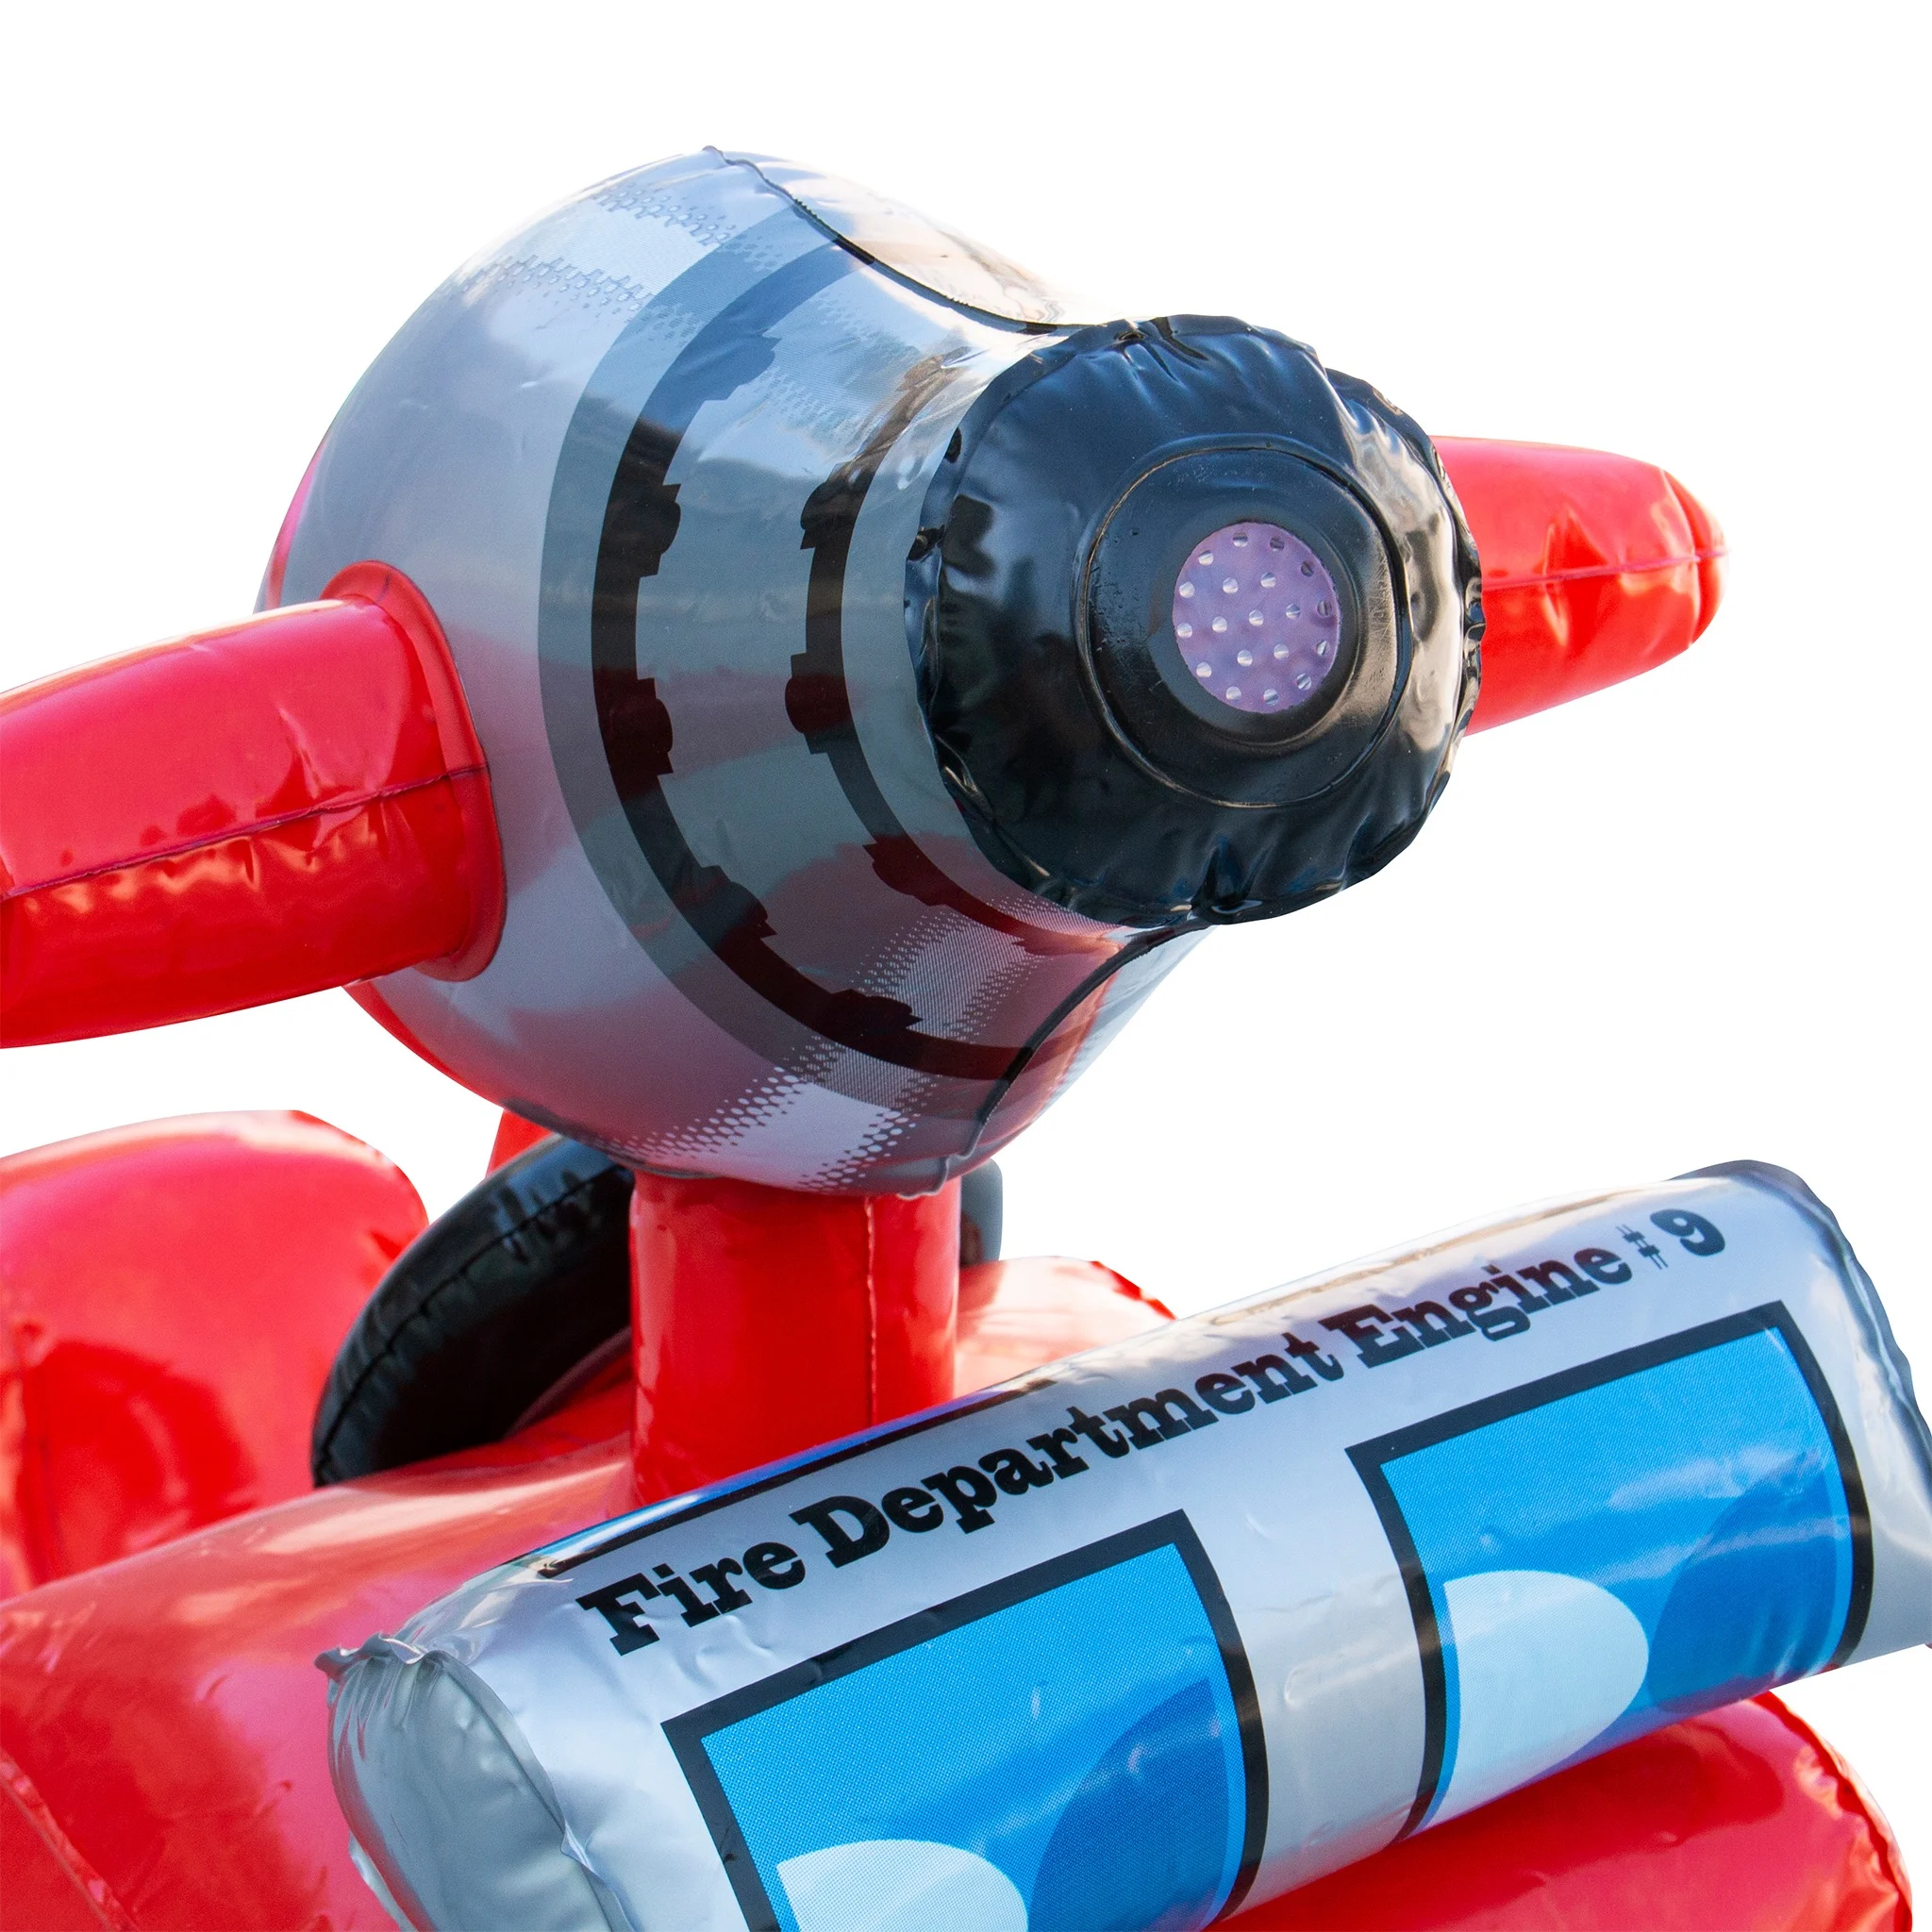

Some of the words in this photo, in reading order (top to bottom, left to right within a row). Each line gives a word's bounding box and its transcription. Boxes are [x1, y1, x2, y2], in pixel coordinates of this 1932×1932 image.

[575, 1541, 806, 1657] Fire
[790, 1333, 1345, 1568] Department
[1321, 1247, 1633, 1369] Engine
